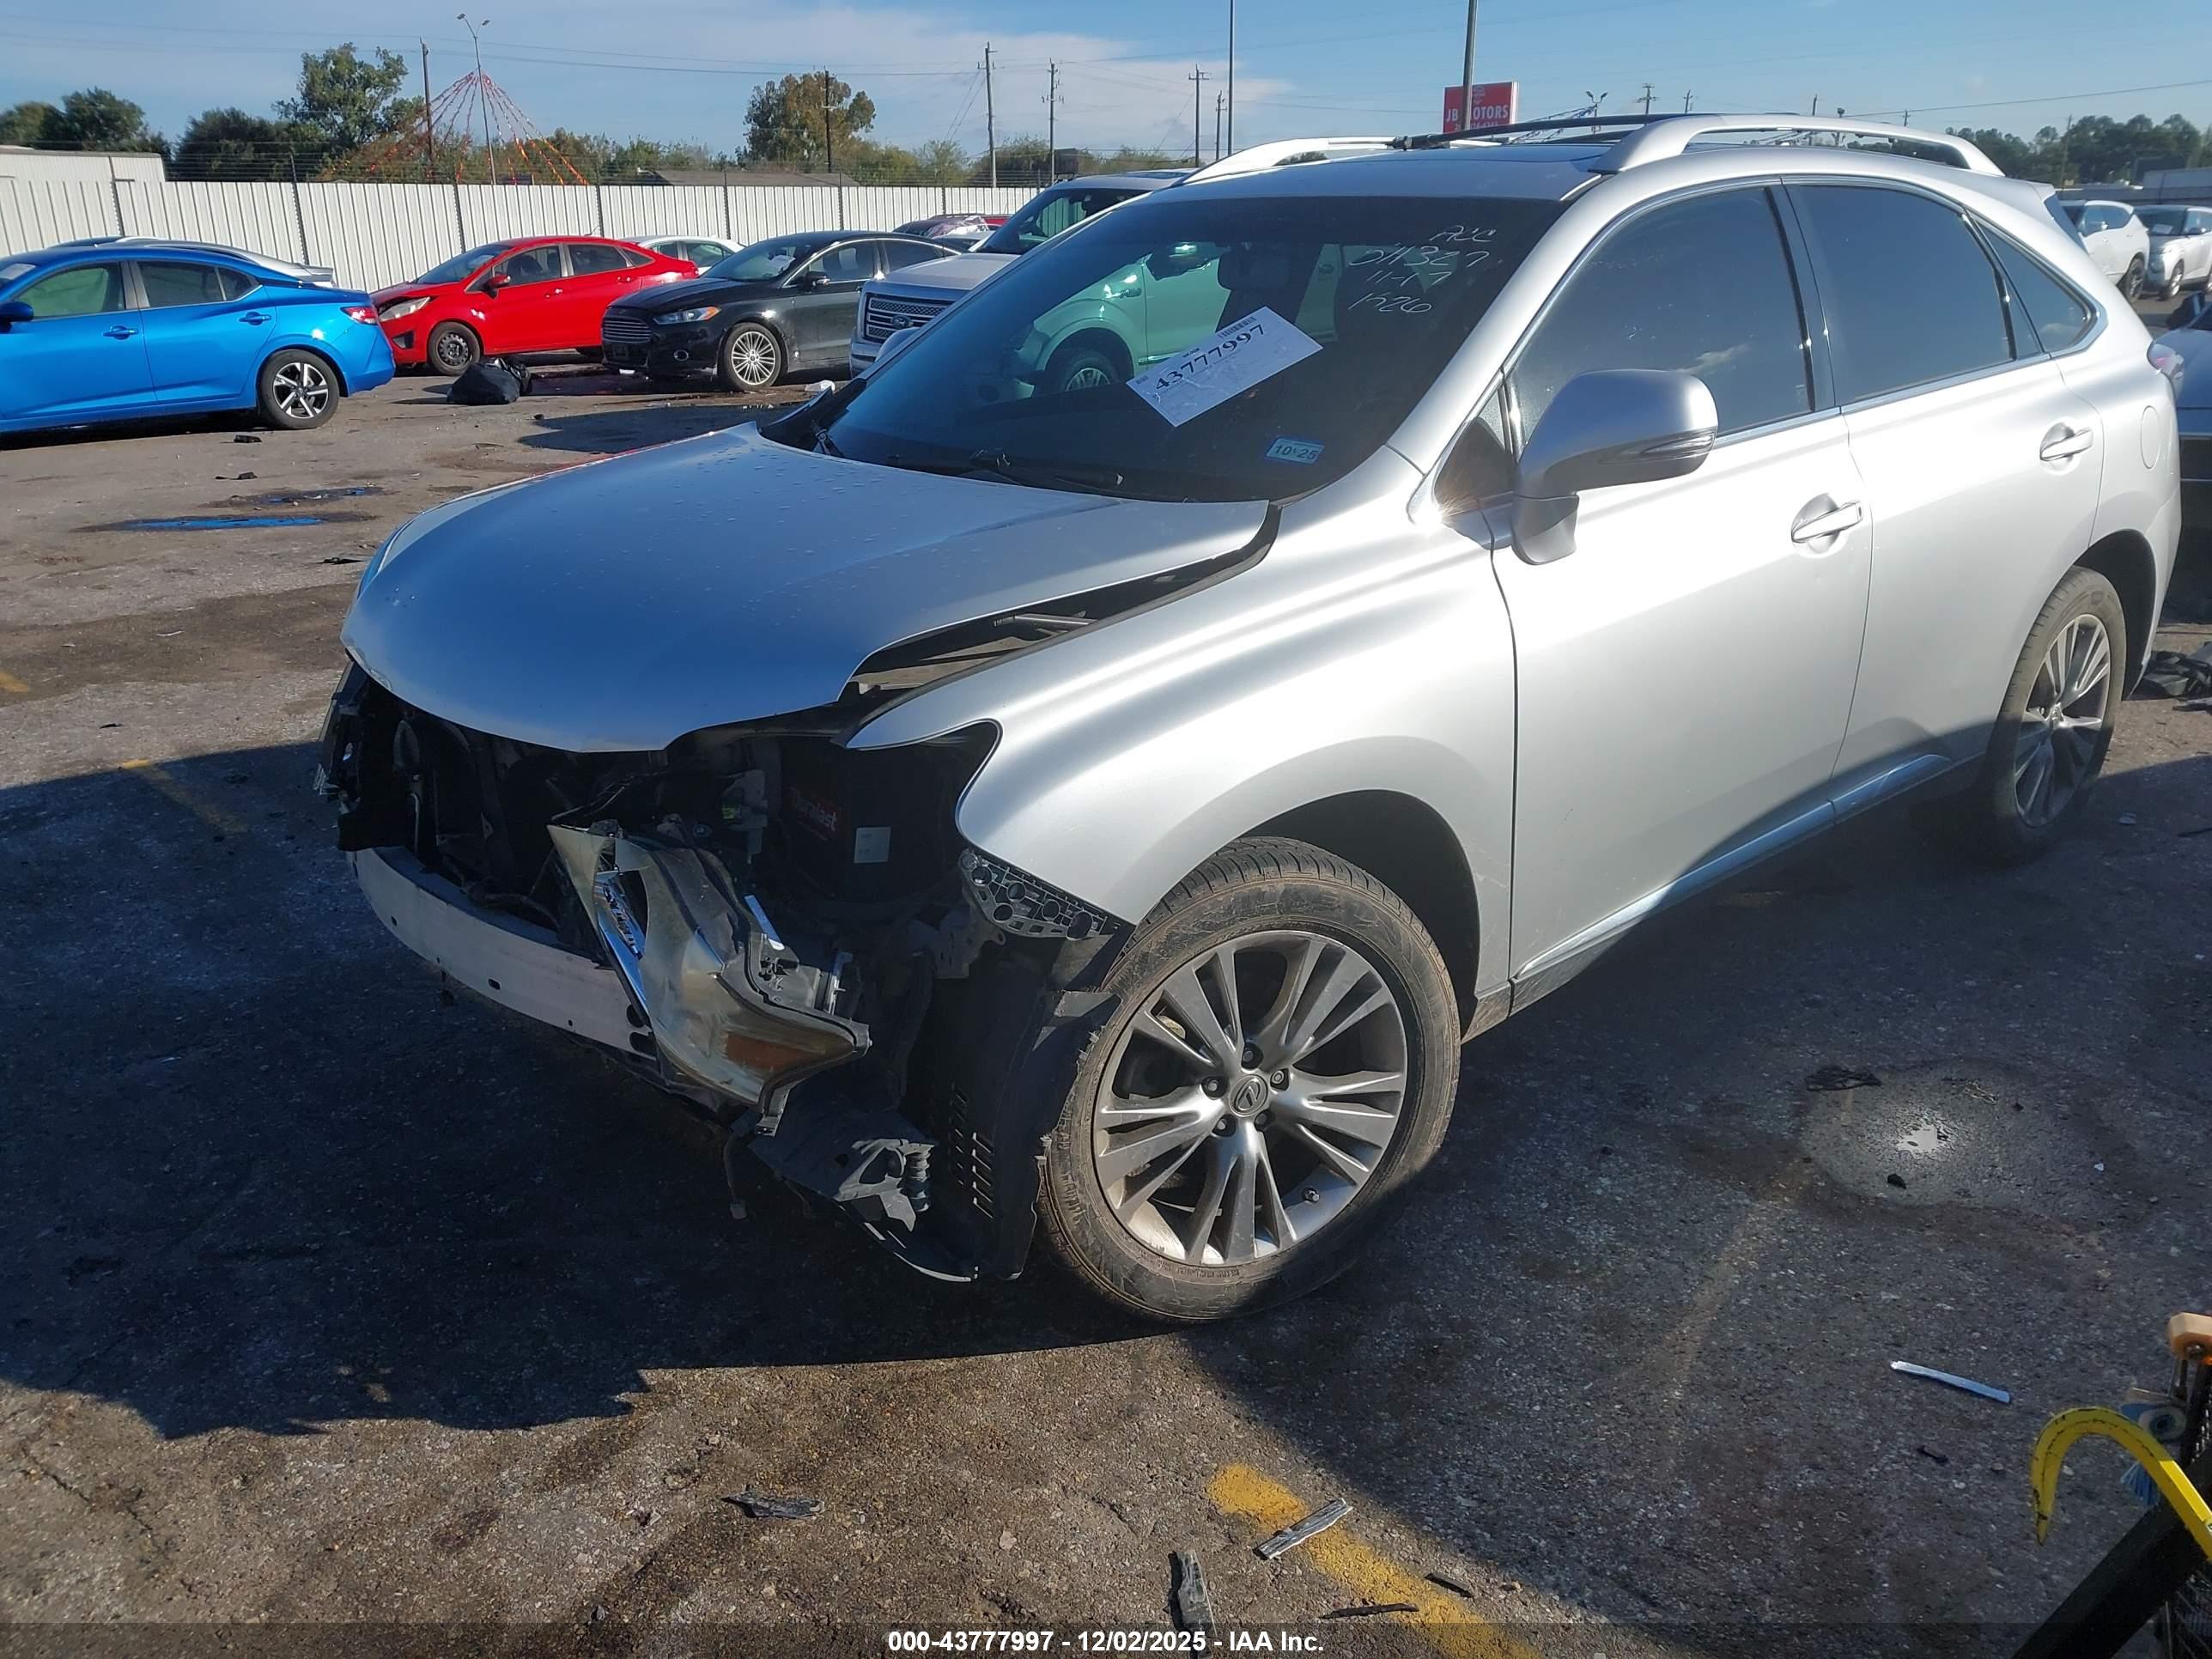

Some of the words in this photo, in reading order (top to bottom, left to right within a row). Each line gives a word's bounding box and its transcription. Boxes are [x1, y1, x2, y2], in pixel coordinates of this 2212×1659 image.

[1473, 105, 1509, 120] OTORS
[1155, 323, 1265, 391] 43777997
[1296, 447, 1319, 460] 25
